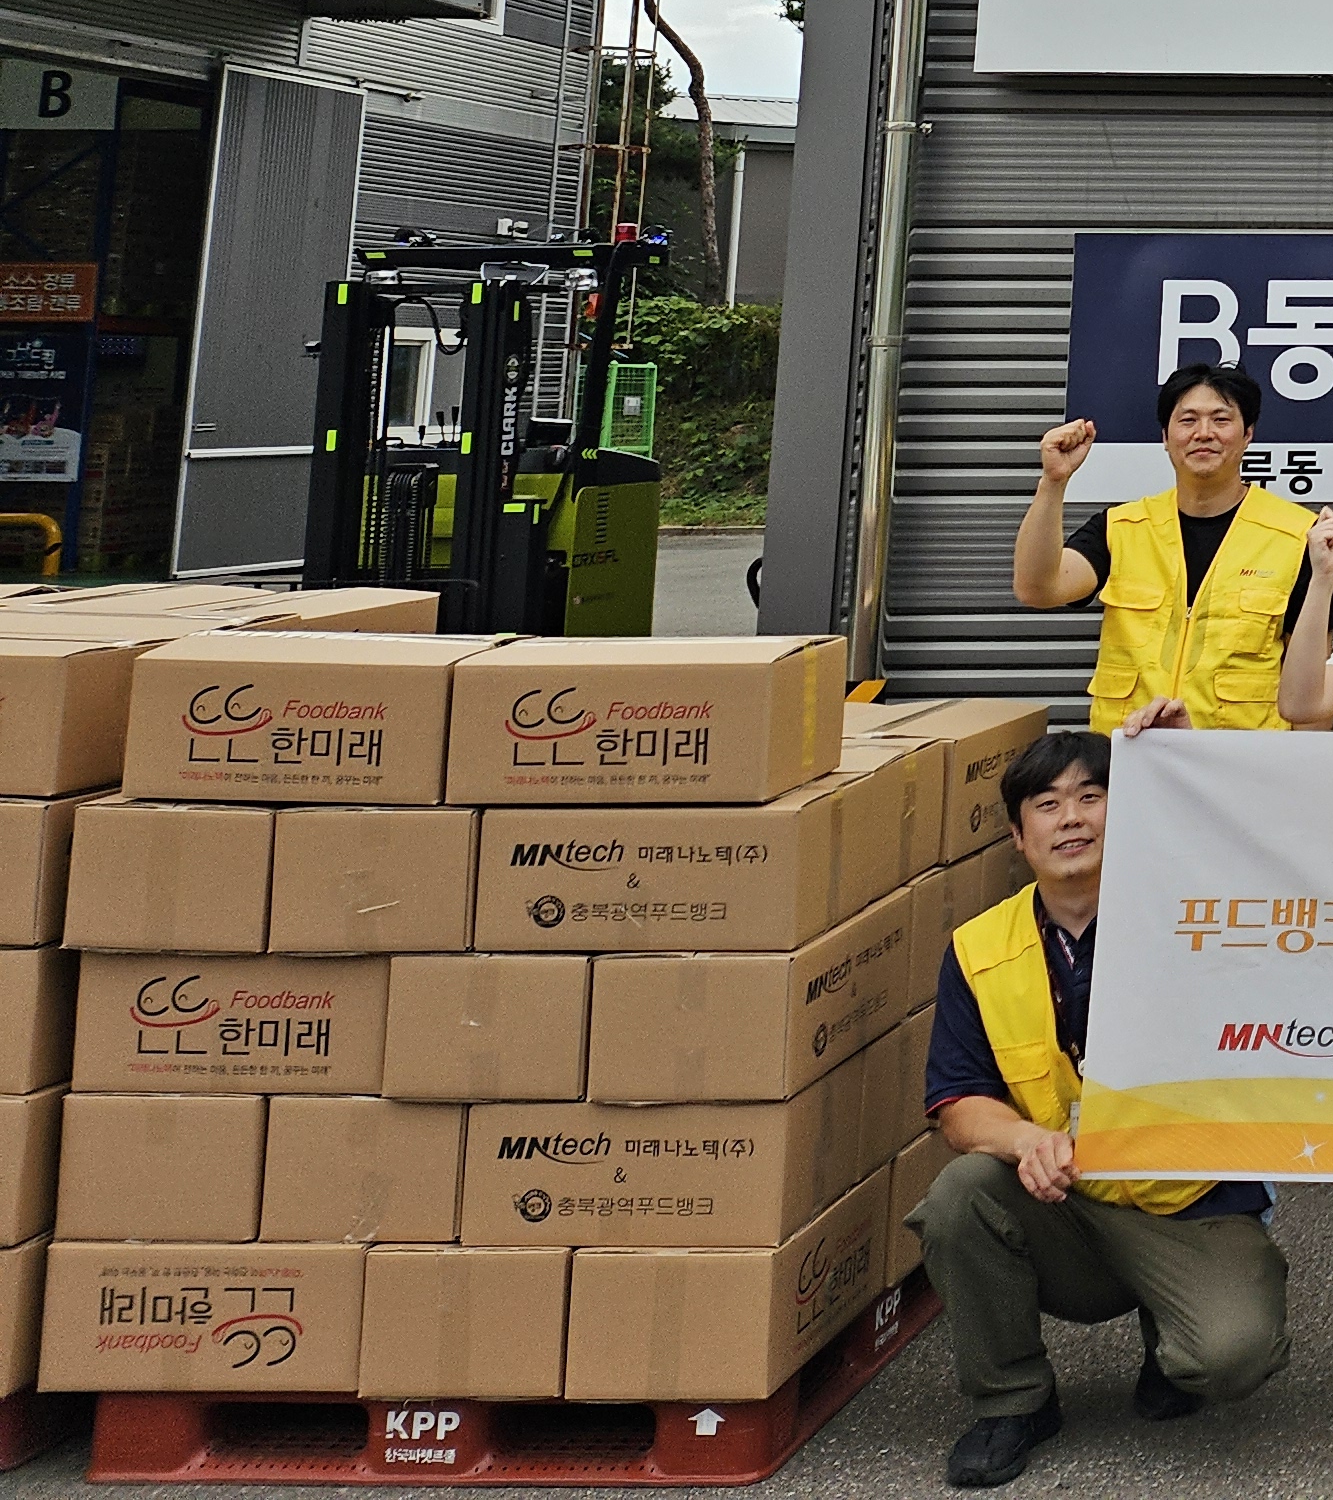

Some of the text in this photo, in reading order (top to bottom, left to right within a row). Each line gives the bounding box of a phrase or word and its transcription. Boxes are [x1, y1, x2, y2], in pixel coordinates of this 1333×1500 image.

[38, 70, 73, 118] B
[501, 386, 518, 456] CLARK
[283, 699, 390, 721] Foodbank
[606, 701, 712, 720] Foodbank
[511, 839, 768, 869] MNtech 미래나노텍(주)
[627, 874, 641, 889] &
[571, 901, 727, 922] 충북광역푸드뱅크
[230, 989, 335, 1010] Foodbank
[498, 1132, 755, 1161] MNtech 미래나노텍(주)
[614, 1167, 628, 1184] &
[556, 1197, 715, 1218] 충북광역푸드뱅크
[874, 1287, 901, 1332] KPP
[95, 1333, 201, 1355] Foodbank
[385, 1410, 460, 1440] KPP
